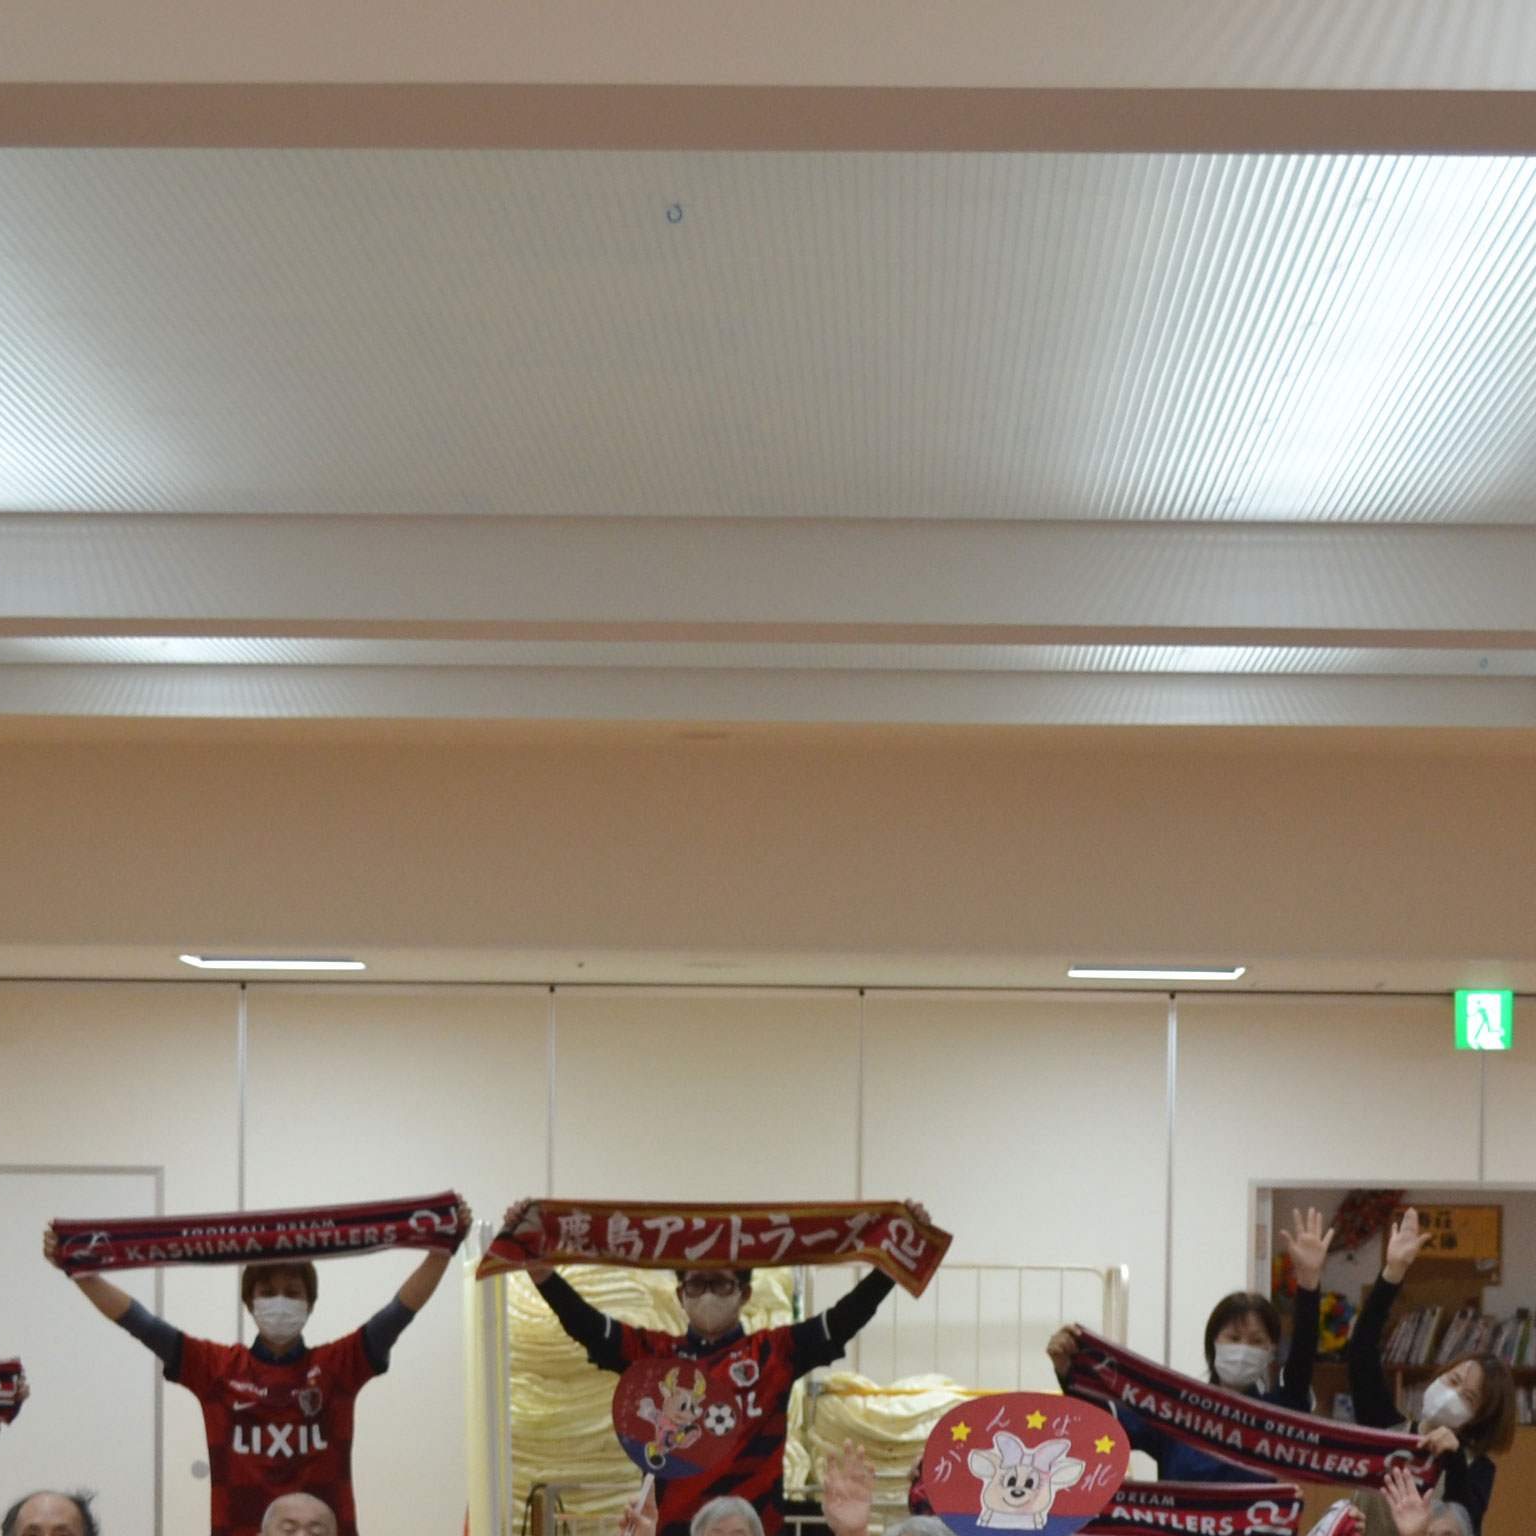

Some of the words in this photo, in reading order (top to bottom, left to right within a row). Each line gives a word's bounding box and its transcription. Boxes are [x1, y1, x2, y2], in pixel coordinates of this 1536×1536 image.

[124, 1236, 263, 1263] KASHIMA
[275, 1224, 398, 1251] ANTLERS
[557, 1207, 878, 1263] 鹿島アントラーズ
[232, 1422, 329, 1459] LIXIL
[1120, 1382, 1244, 1450] KASHIMA
[1252, 1438, 1370, 1479] ANTLERS
[1179, 1389, 1258, 1428] FOOTBALL
[1264, 1418, 1321, 1445] DREAM
